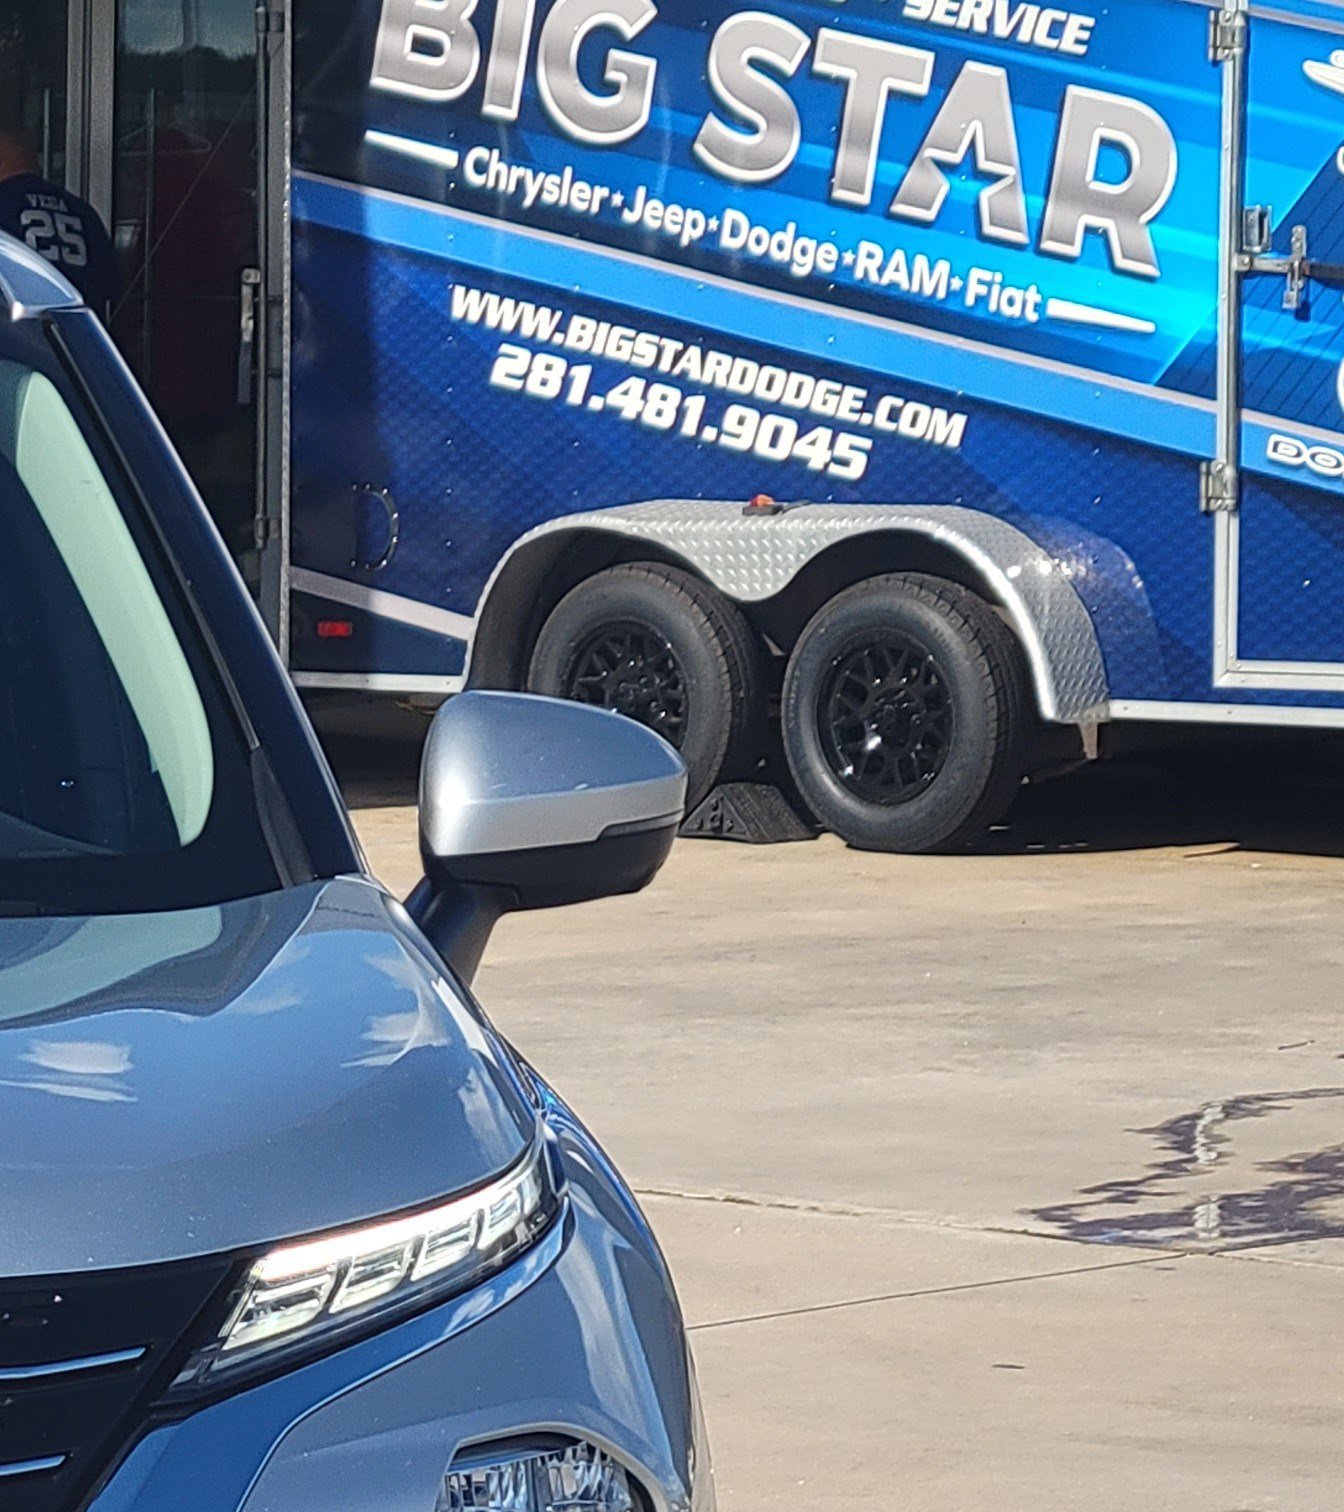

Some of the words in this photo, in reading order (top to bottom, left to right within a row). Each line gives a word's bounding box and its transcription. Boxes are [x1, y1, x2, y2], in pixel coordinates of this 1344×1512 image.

[370, 0, 658, 145] BIG
[693, 10, 1178, 278] STAR
[20, 209, 87, 267] 25
[463, 146, 606, 212] Chrysler
[620, 185, 707, 246] Jeep
[719, 208, 837, 274] Dodge
[854, 241, 949, 300] RAM
[966, 267, 1043, 323] Fiat
[450, 284, 969, 448] WWW.BIGSTARDODGE.COM
[489, 342, 875, 482] 281.481.9045
